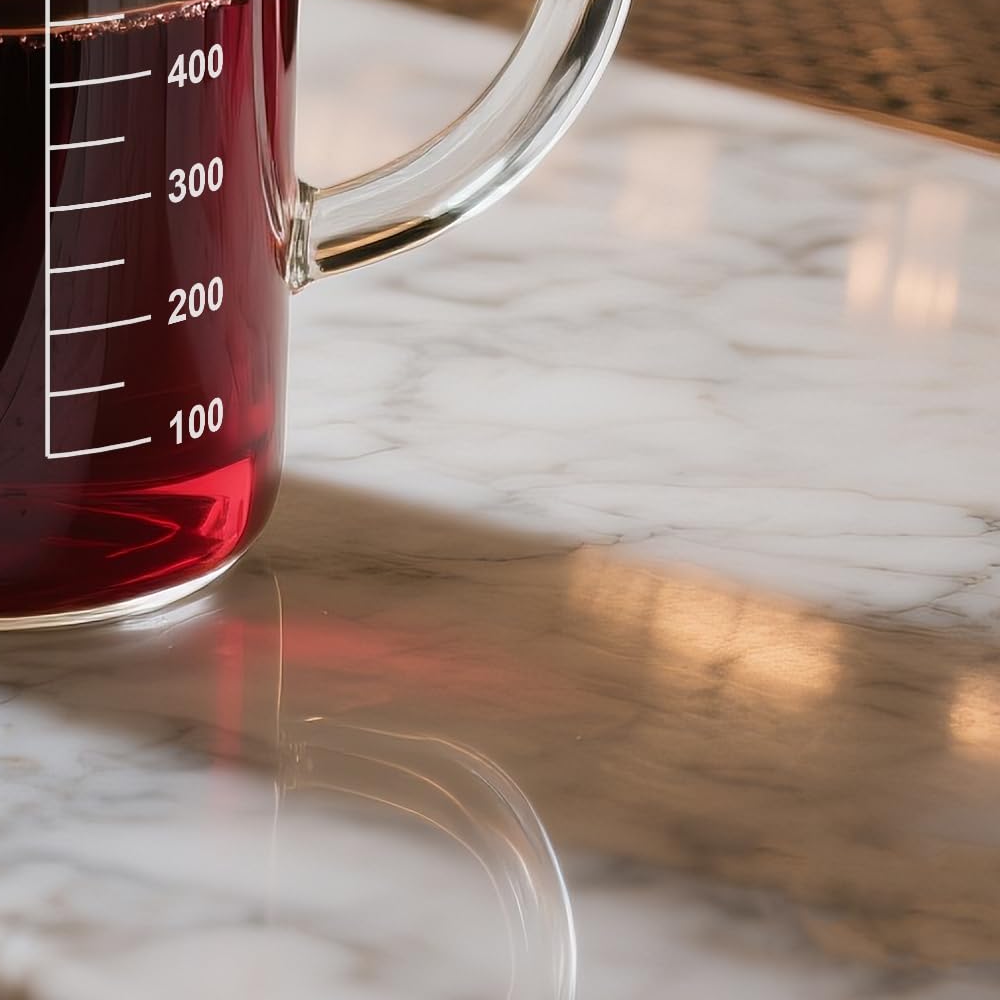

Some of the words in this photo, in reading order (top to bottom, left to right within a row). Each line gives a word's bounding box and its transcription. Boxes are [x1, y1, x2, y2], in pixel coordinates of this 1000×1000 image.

[167, 43, 224, 88] 400
[168, 156, 224, 204] 300
[167, 276, 224, 326] 200
[169, 397, 224, 445] 100
